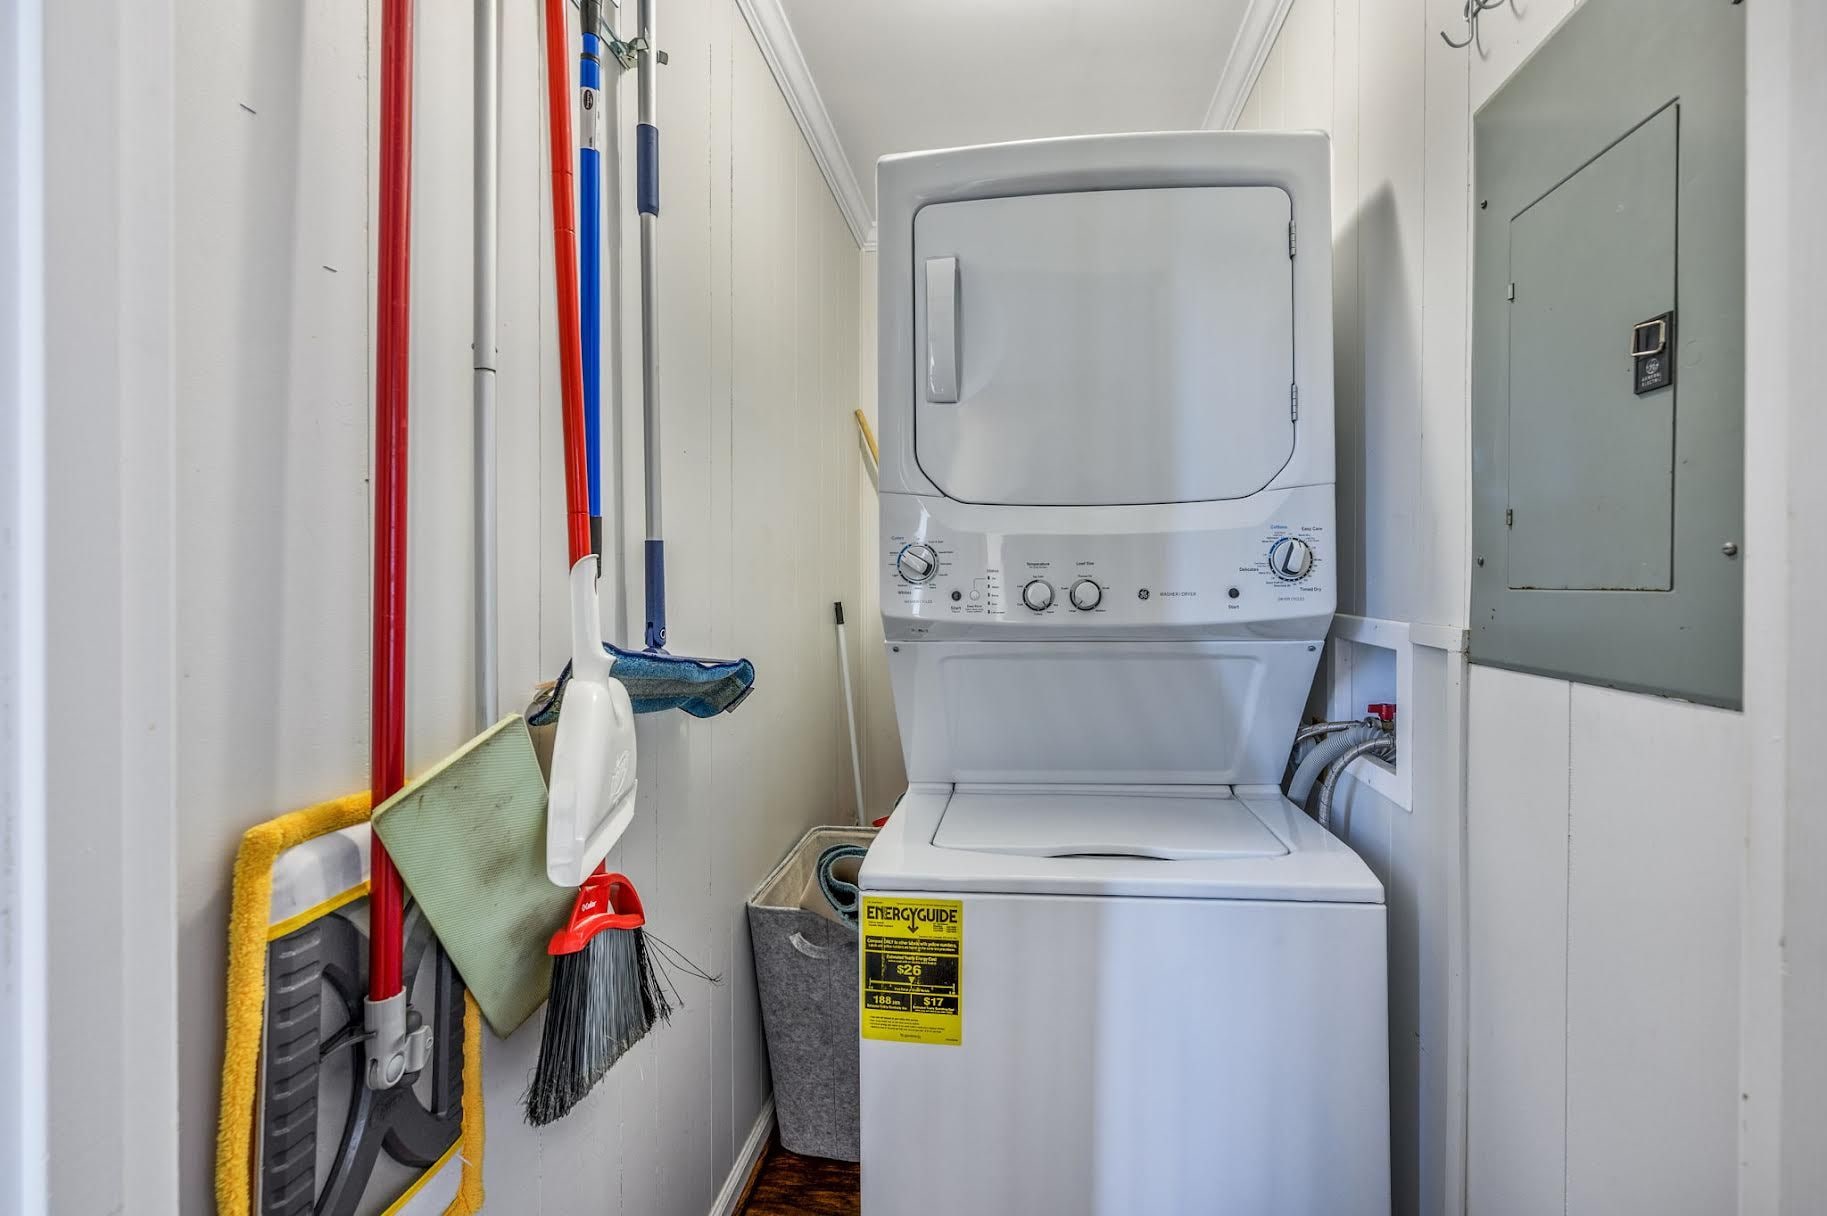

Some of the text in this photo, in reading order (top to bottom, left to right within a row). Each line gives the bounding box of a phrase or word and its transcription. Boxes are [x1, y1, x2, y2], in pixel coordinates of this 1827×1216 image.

[866, 905, 958, 924] ENERGYGUIDE
[896, 964, 922, 976] $26
[873, 994, 892, 1005] 188
[923, 997, 944, 1006] $17
